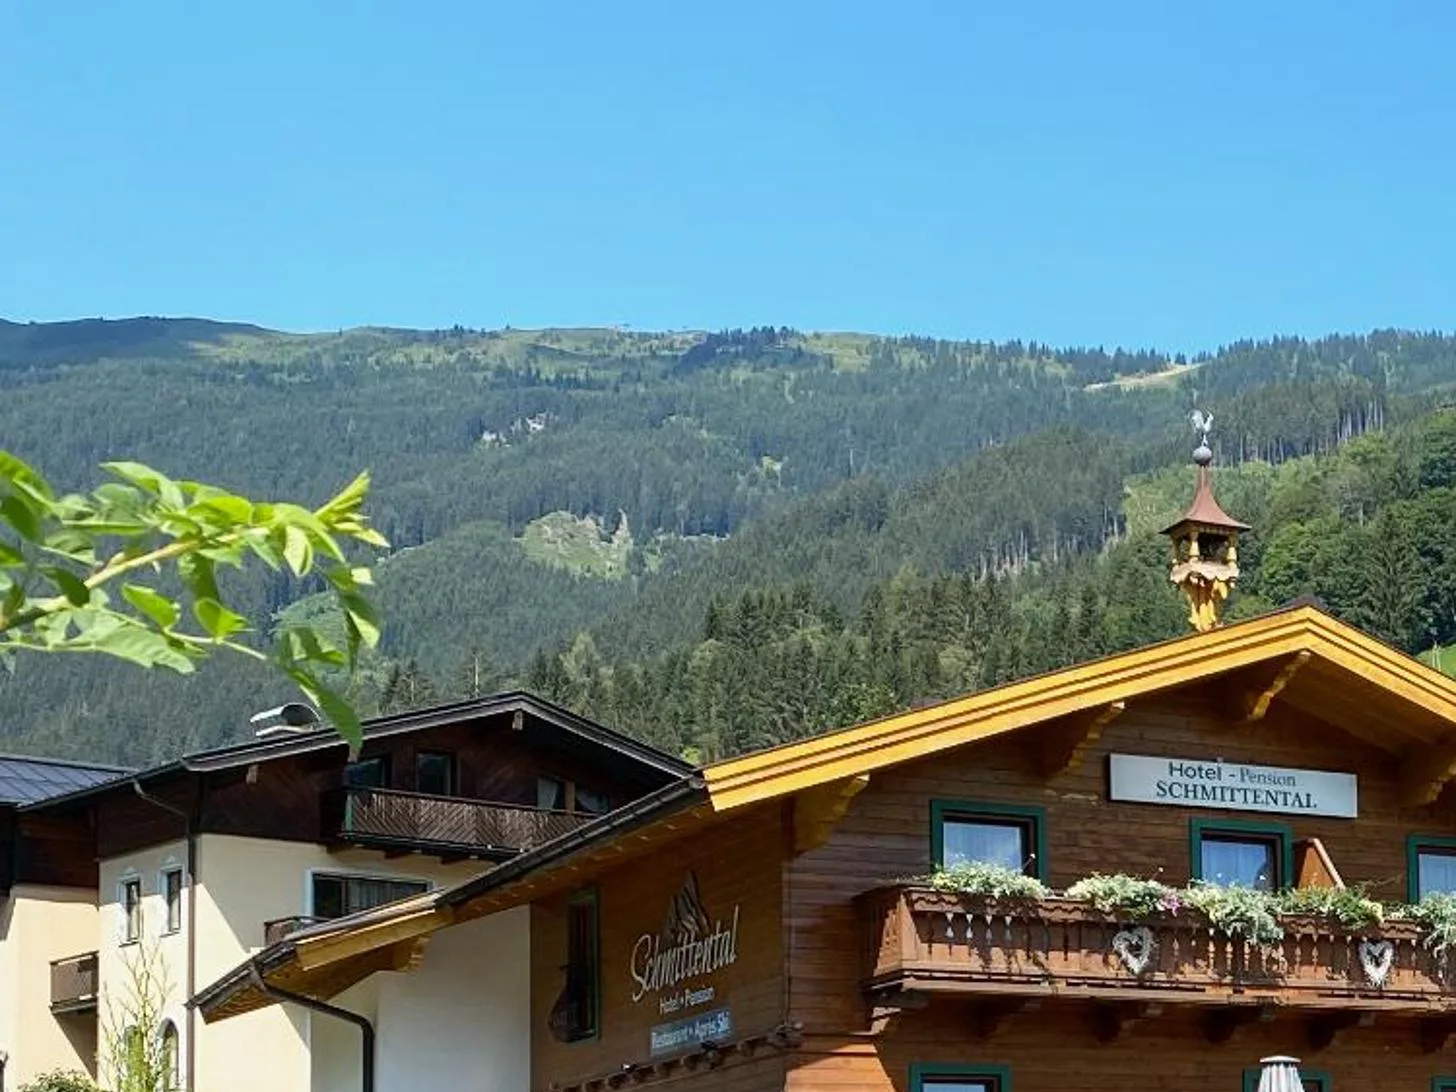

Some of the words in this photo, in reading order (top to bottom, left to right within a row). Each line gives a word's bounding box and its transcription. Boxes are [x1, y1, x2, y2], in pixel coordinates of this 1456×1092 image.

[1168, 762, 1222, 780] Hotel
[1240, 766, 1296, 786] Pension
[1156, 781, 1317, 809] SCHMITTENTAL
[631, 904, 739, 1002] Schmittental
